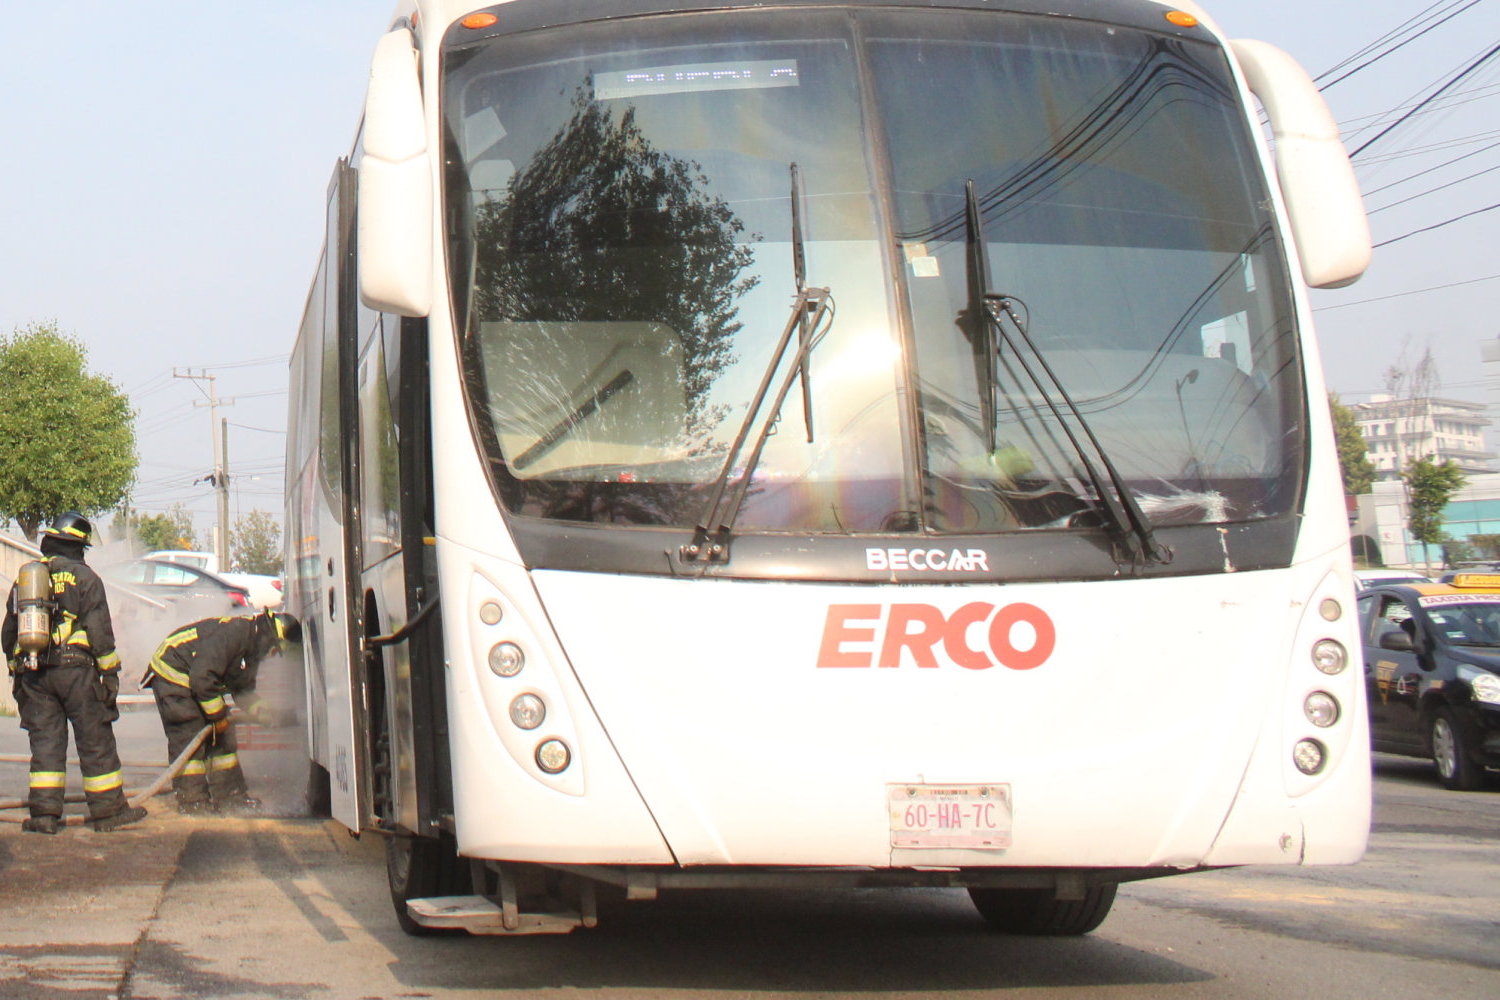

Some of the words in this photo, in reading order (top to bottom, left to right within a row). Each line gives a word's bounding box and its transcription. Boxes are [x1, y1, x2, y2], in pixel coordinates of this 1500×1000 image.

[866, 548, 989, 571] BECCAR
[1421, 595, 1472, 604] TAXISTA
[816, 601, 1056, 671] ERCO
[905, 802, 996, 828] 60-HA-7C
